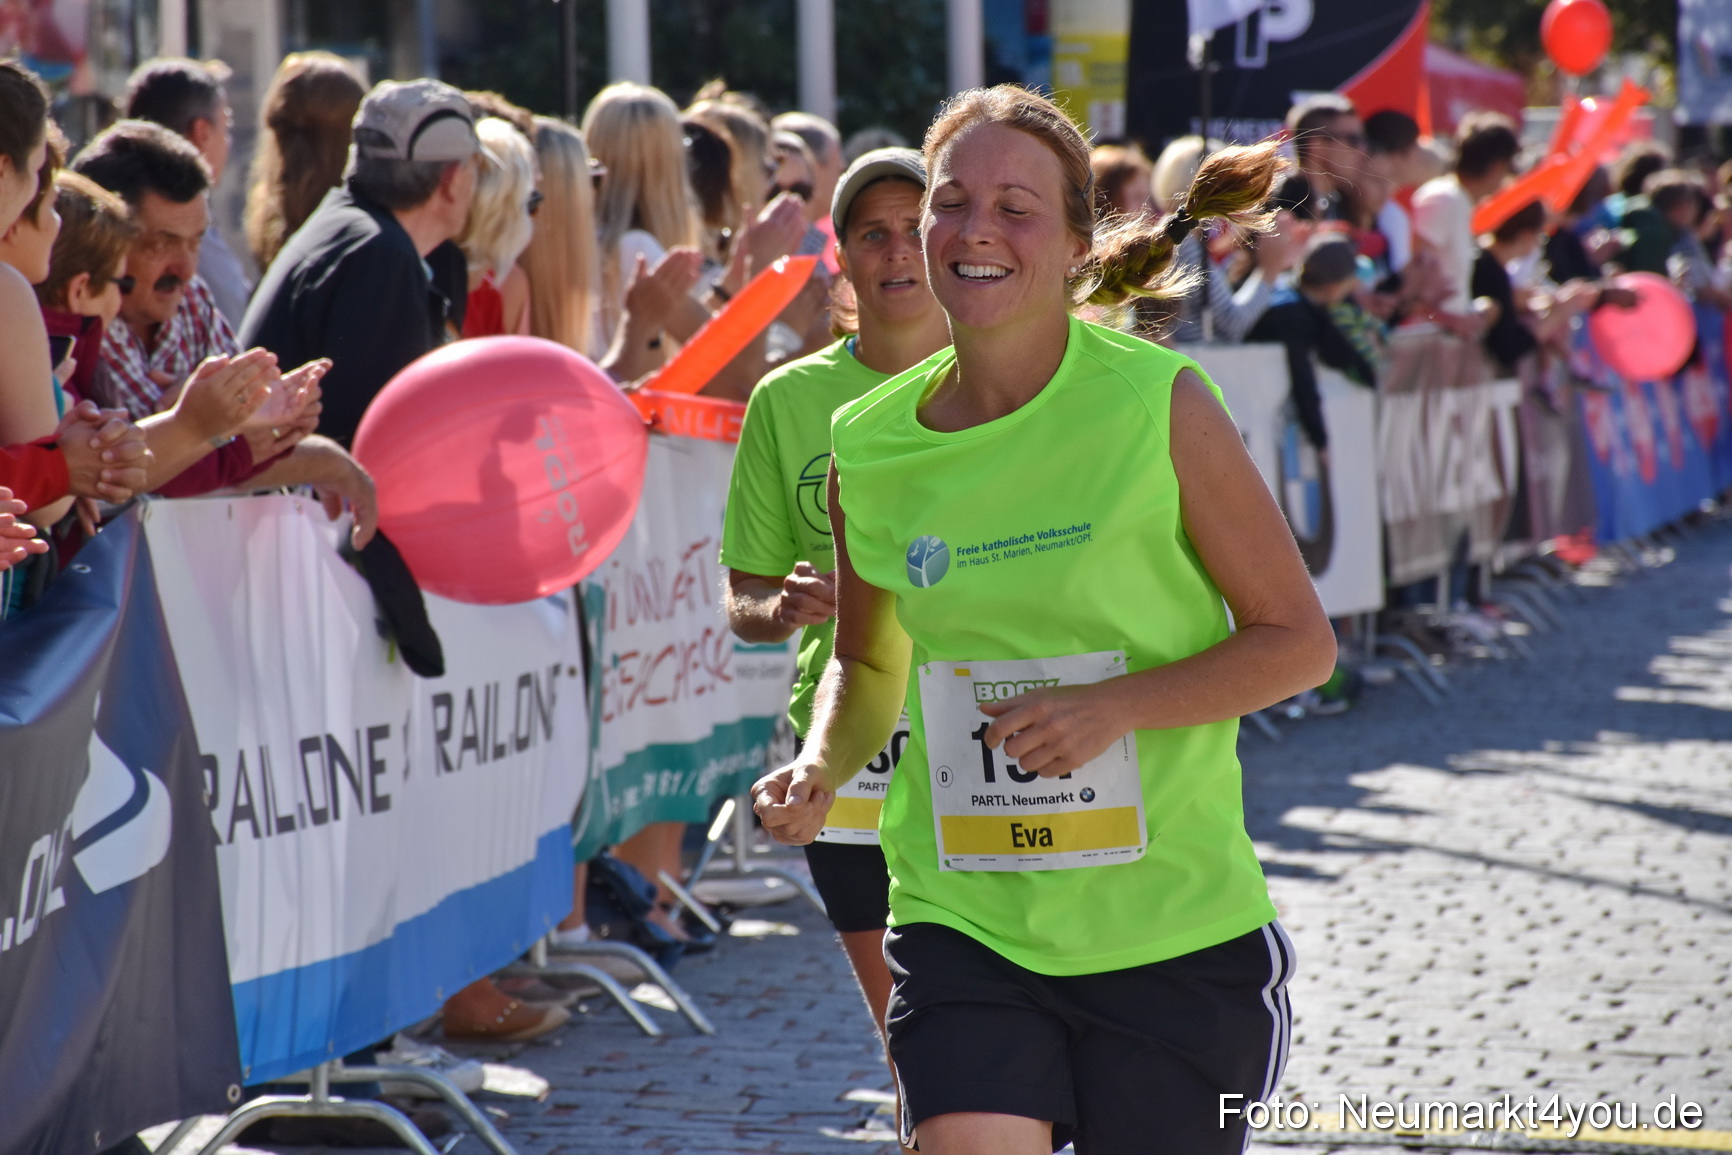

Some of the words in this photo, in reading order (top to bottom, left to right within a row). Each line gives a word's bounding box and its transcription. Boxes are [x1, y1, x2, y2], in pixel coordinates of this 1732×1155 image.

[956, 545, 980, 557] Freie
[982, 533, 1035, 552] katholische
[1037, 522, 1092, 541] Volksschule
[956, 558, 968, 569] im
[969, 556, 990, 567] Haus
[991, 552, 1002, 563] St.
[1003, 546, 1033, 560] Marien,
[1034, 532, 1094, 553] Neumarkt/OPf.
[200, 724, 391, 845] RAIL.ONE
[858, 782, 889, 793] PART
[941, 771, 948, 783] D
[971, 795, 1010, 806] PARTL
[1012, 792, 1075, 806] Neumarkt
[1010, 823, 1054, 848] Eva
